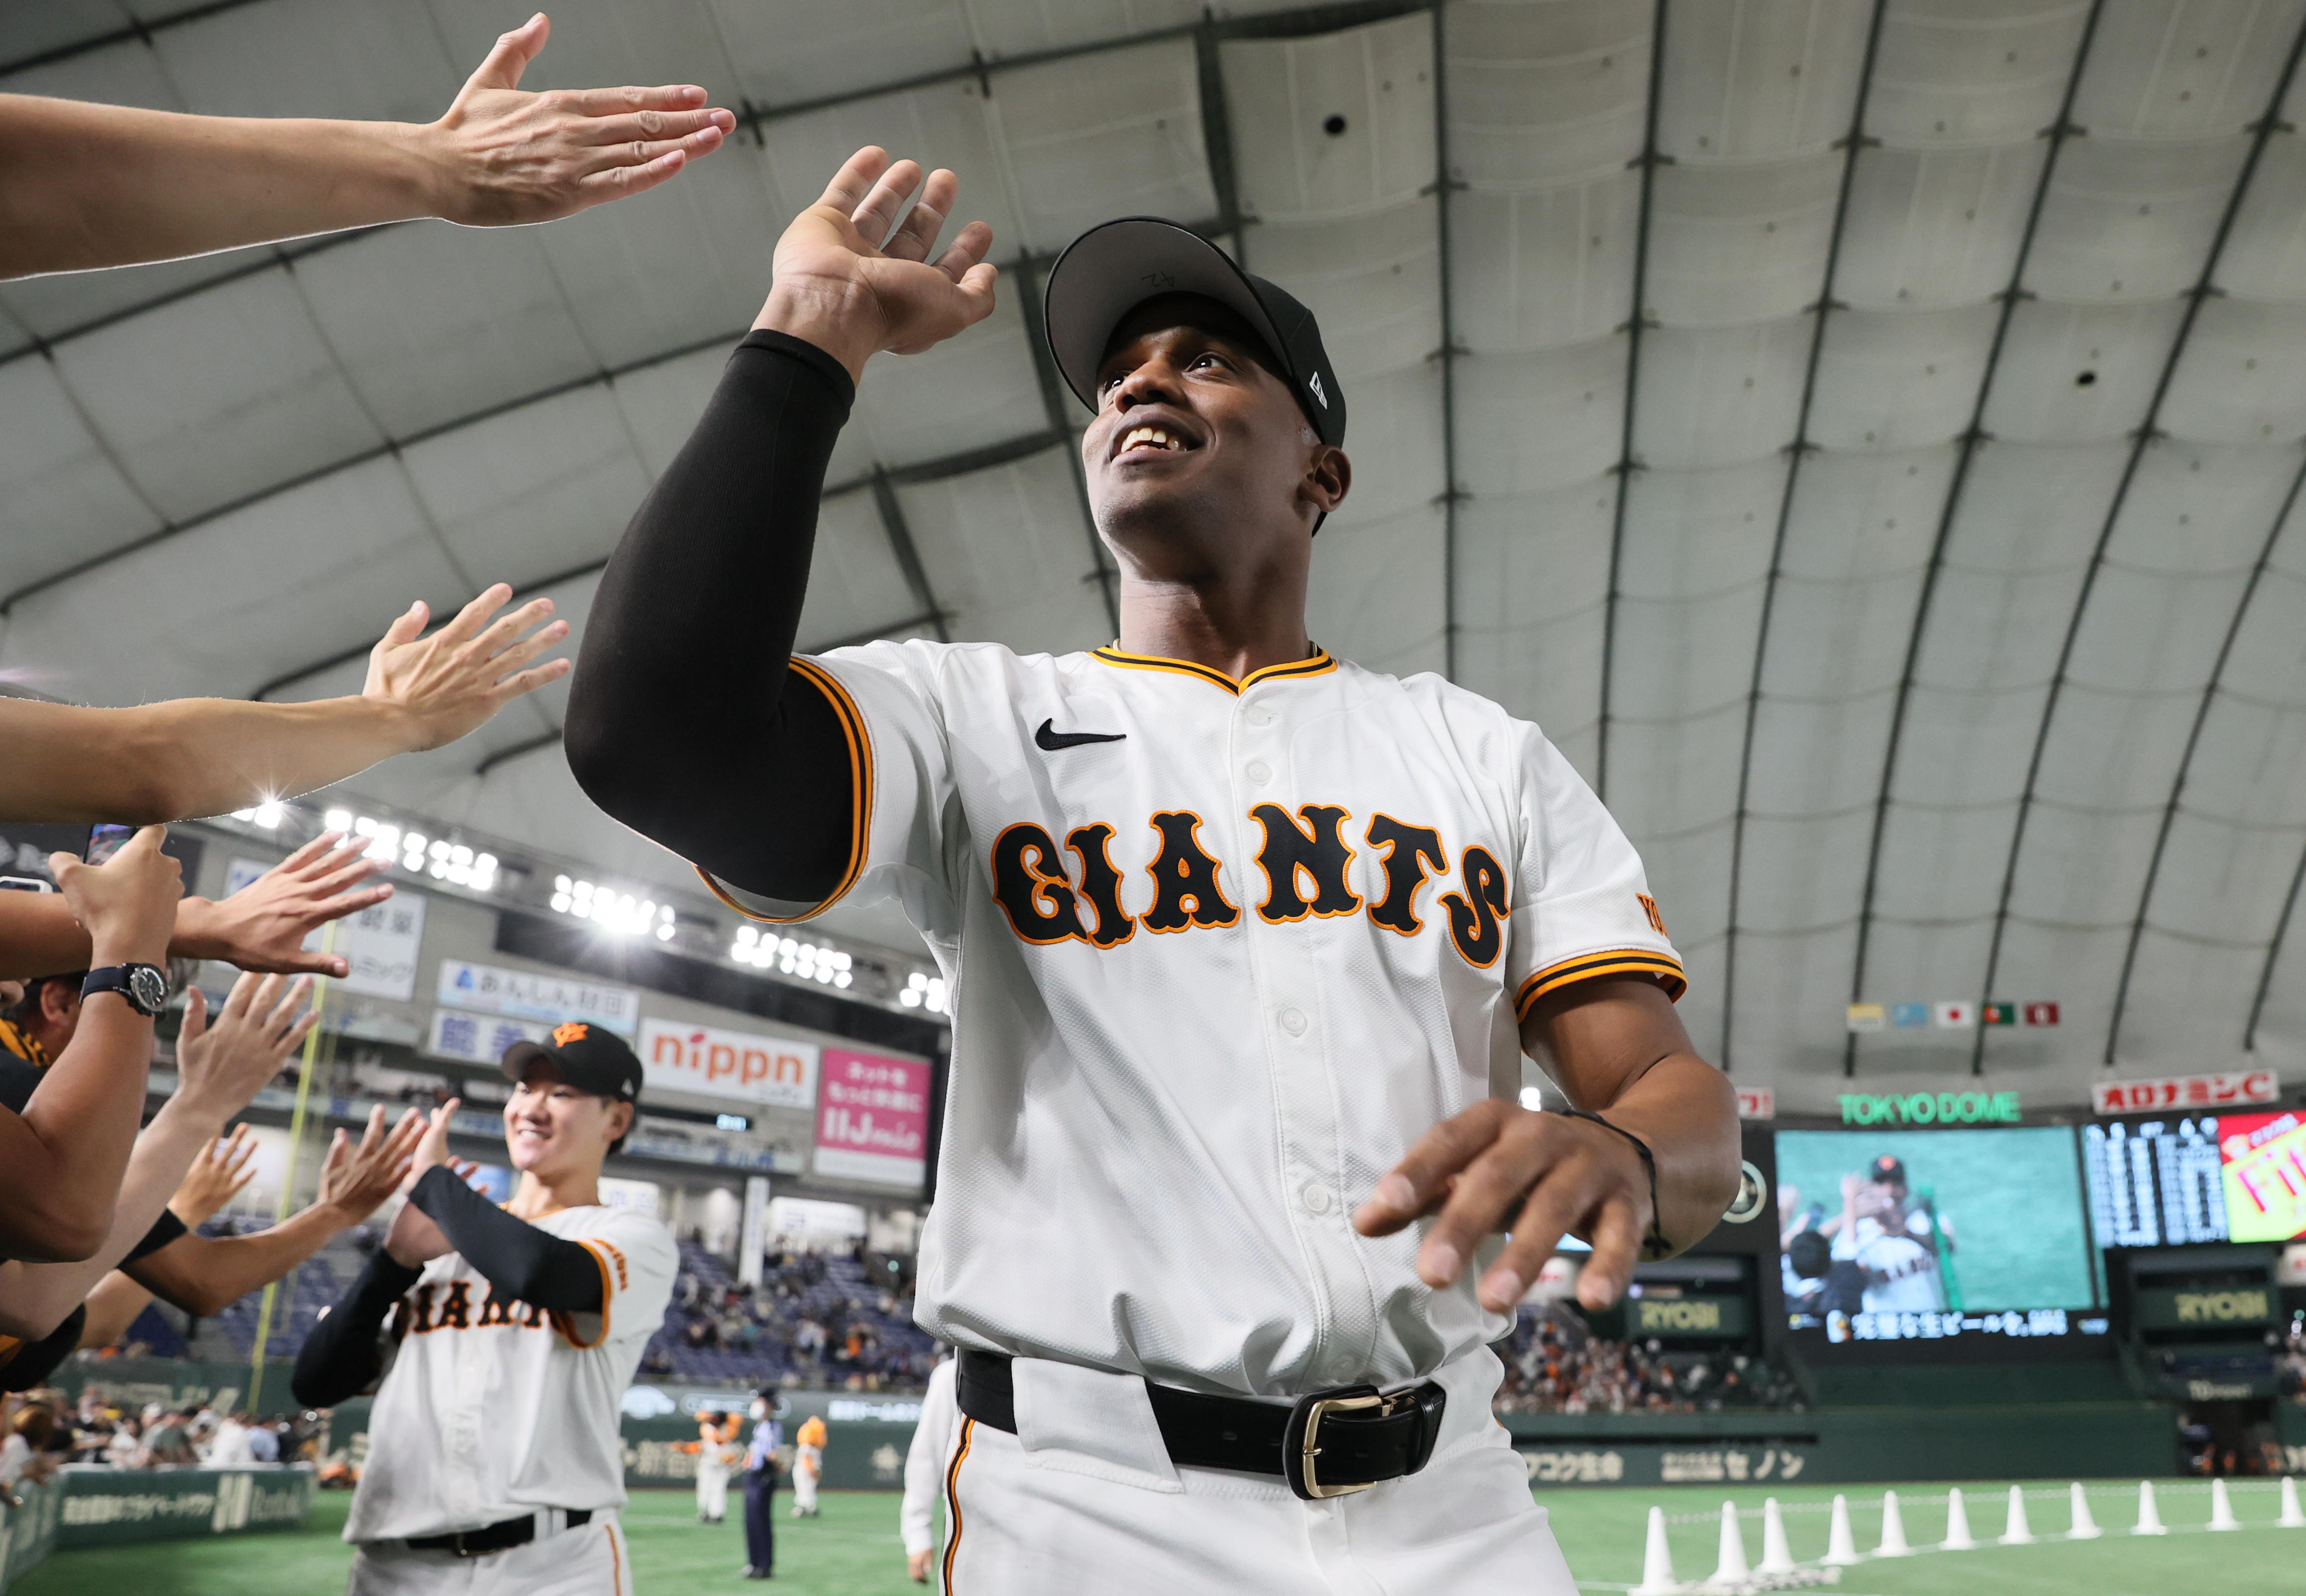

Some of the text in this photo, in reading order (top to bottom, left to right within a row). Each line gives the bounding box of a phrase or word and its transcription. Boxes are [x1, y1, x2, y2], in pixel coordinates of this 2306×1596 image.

[991, 802, 1511, 970] GIANTS
[653, 1033, 804, 1085] nippn
[1837, 1091, 2021, 1124] TOKYO DOME
